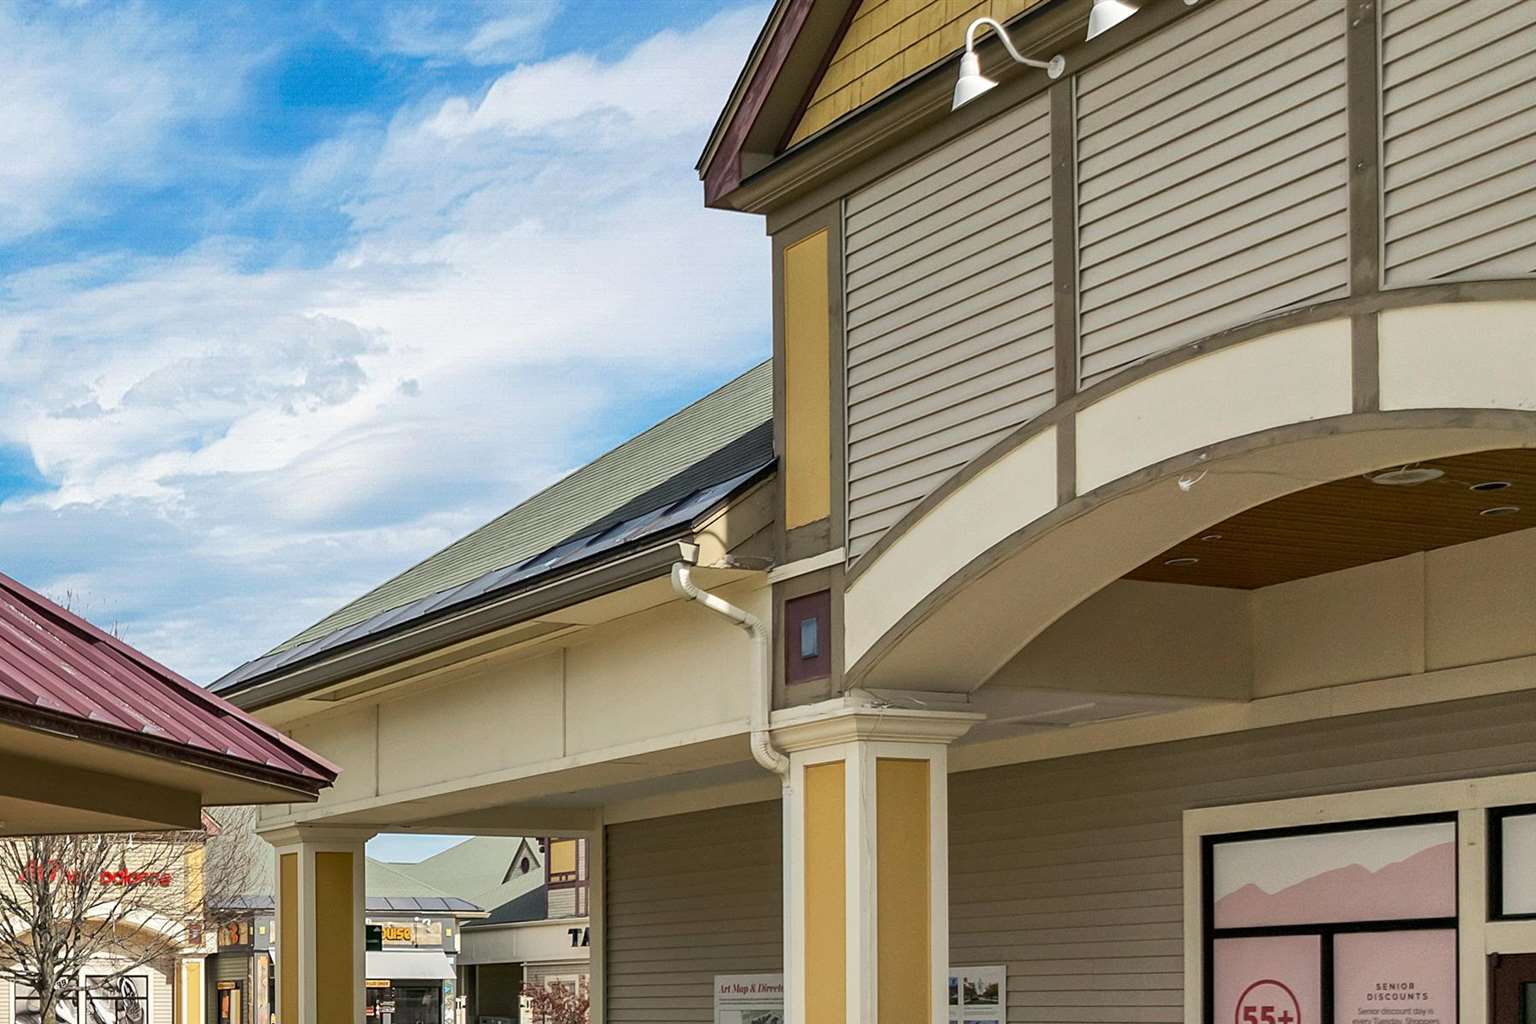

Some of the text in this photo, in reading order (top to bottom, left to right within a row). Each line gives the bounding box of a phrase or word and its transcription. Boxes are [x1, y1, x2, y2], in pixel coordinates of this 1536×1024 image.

[720, 984, 731, 993] Art
[732, 984, 749, 995] Map
[750, 984, 757, 993] &
[1375, 982, 1415, 991] SENIOR
[1366, 992, 1429, 1001] DISCOUNTS
[1358, 1007, 1379, 1015] Senior
[1380, 1007, 1412, 1015] discount
[1413, 1007, 1426, 1016] day
